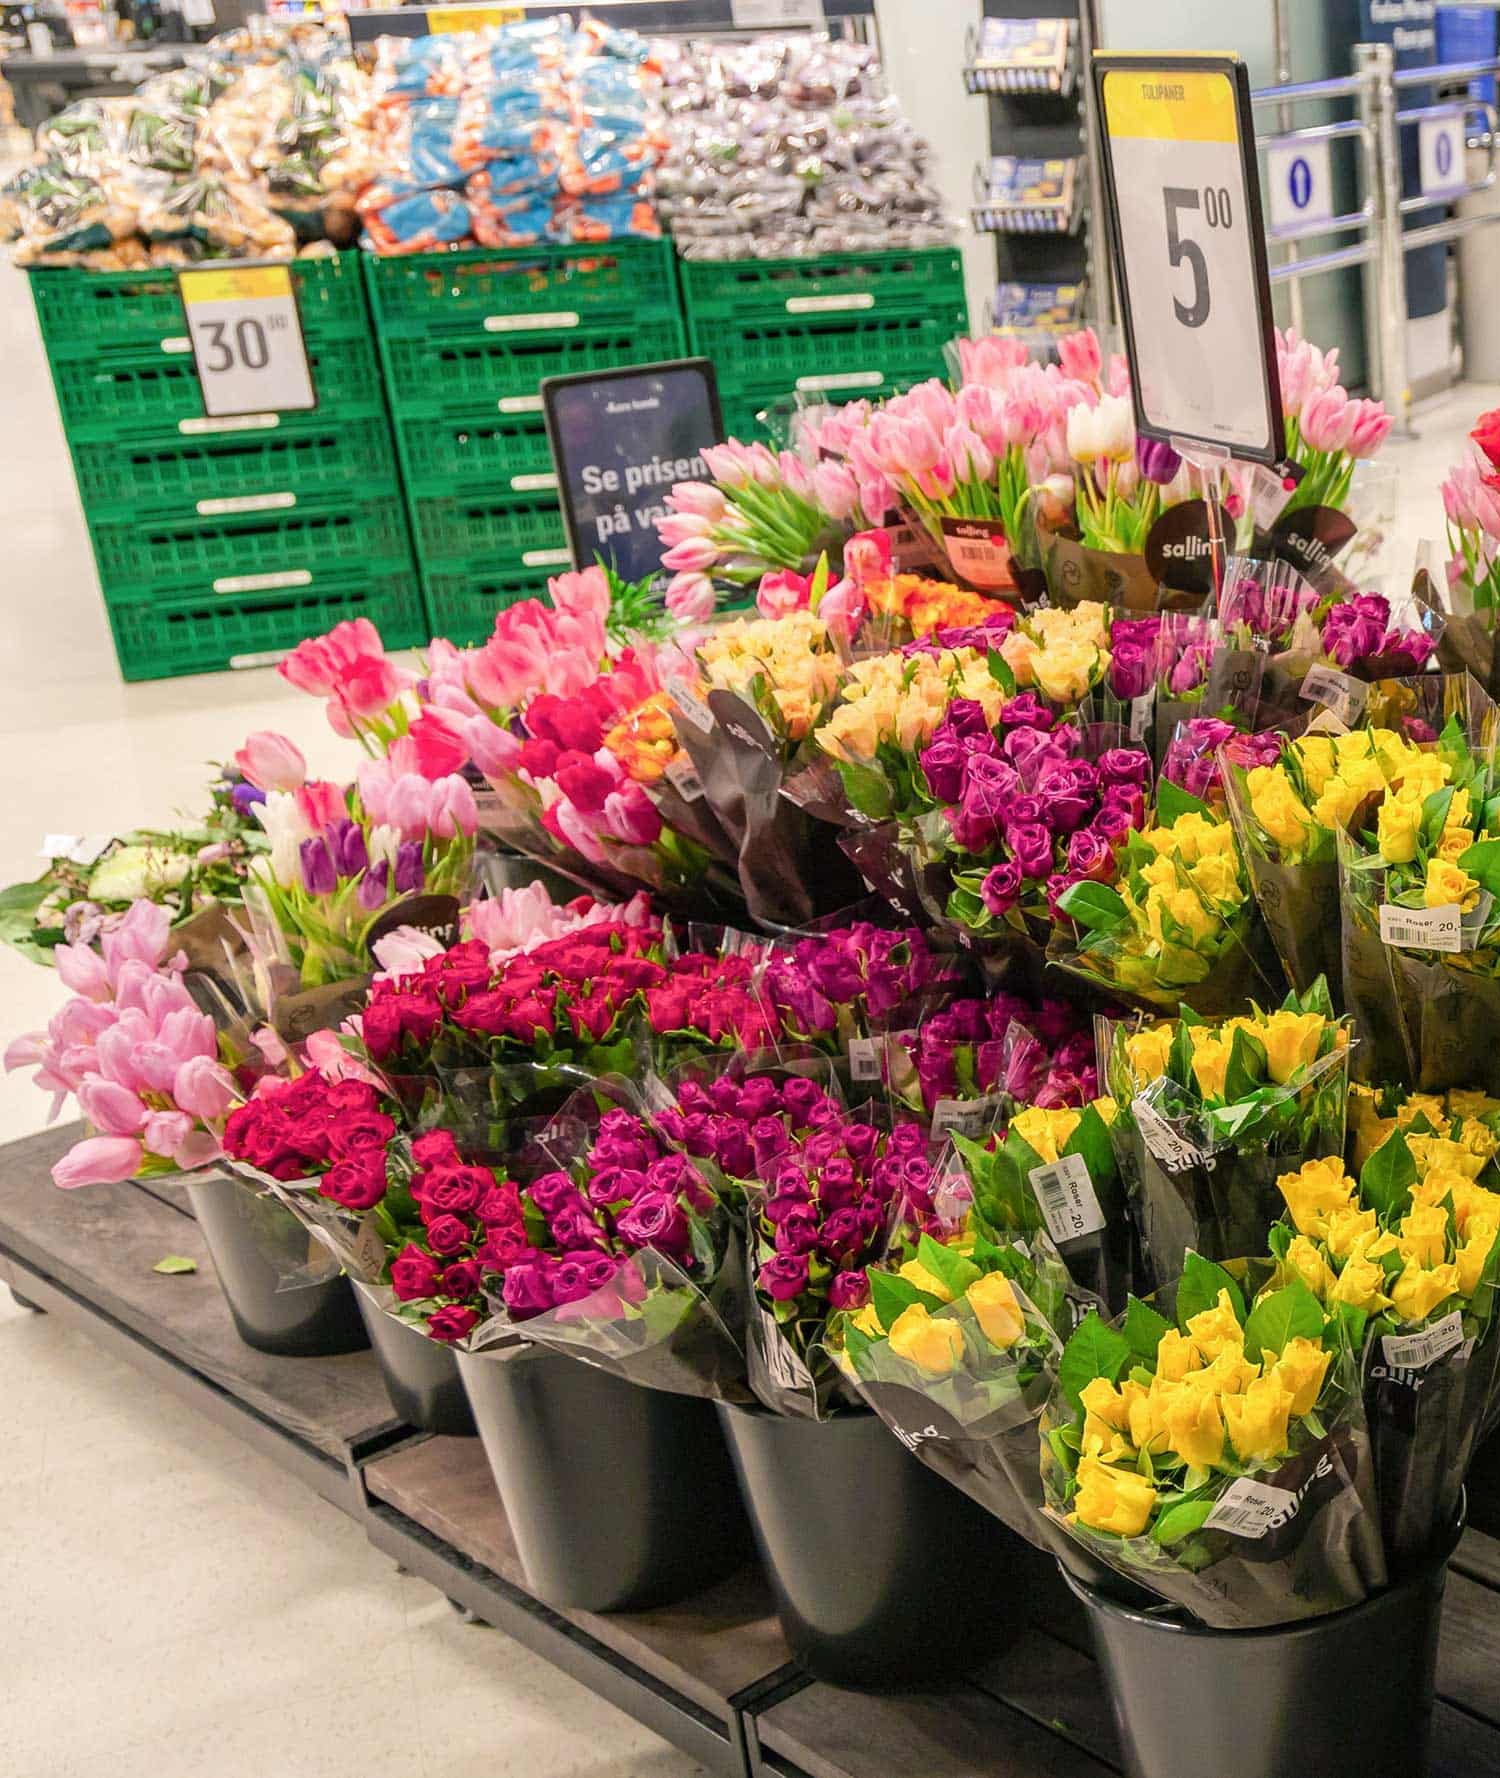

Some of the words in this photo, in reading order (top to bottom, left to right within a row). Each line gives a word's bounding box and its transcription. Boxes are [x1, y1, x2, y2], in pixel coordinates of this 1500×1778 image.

[1142, 84, 1184, 101] TULIPANER
[1162, 186, 1210, 328] 5
[199, 319, 269, 372] 30
[582, 464, 619, 494] Se
[625, 455, 708, 495] prisen
[596, 504, 632, 544] på
[1162, 535, 1213, 561] sallin
[1405, 918, 1433, 928] Roser
[1069, 1181, 1083, 1208] Roser
